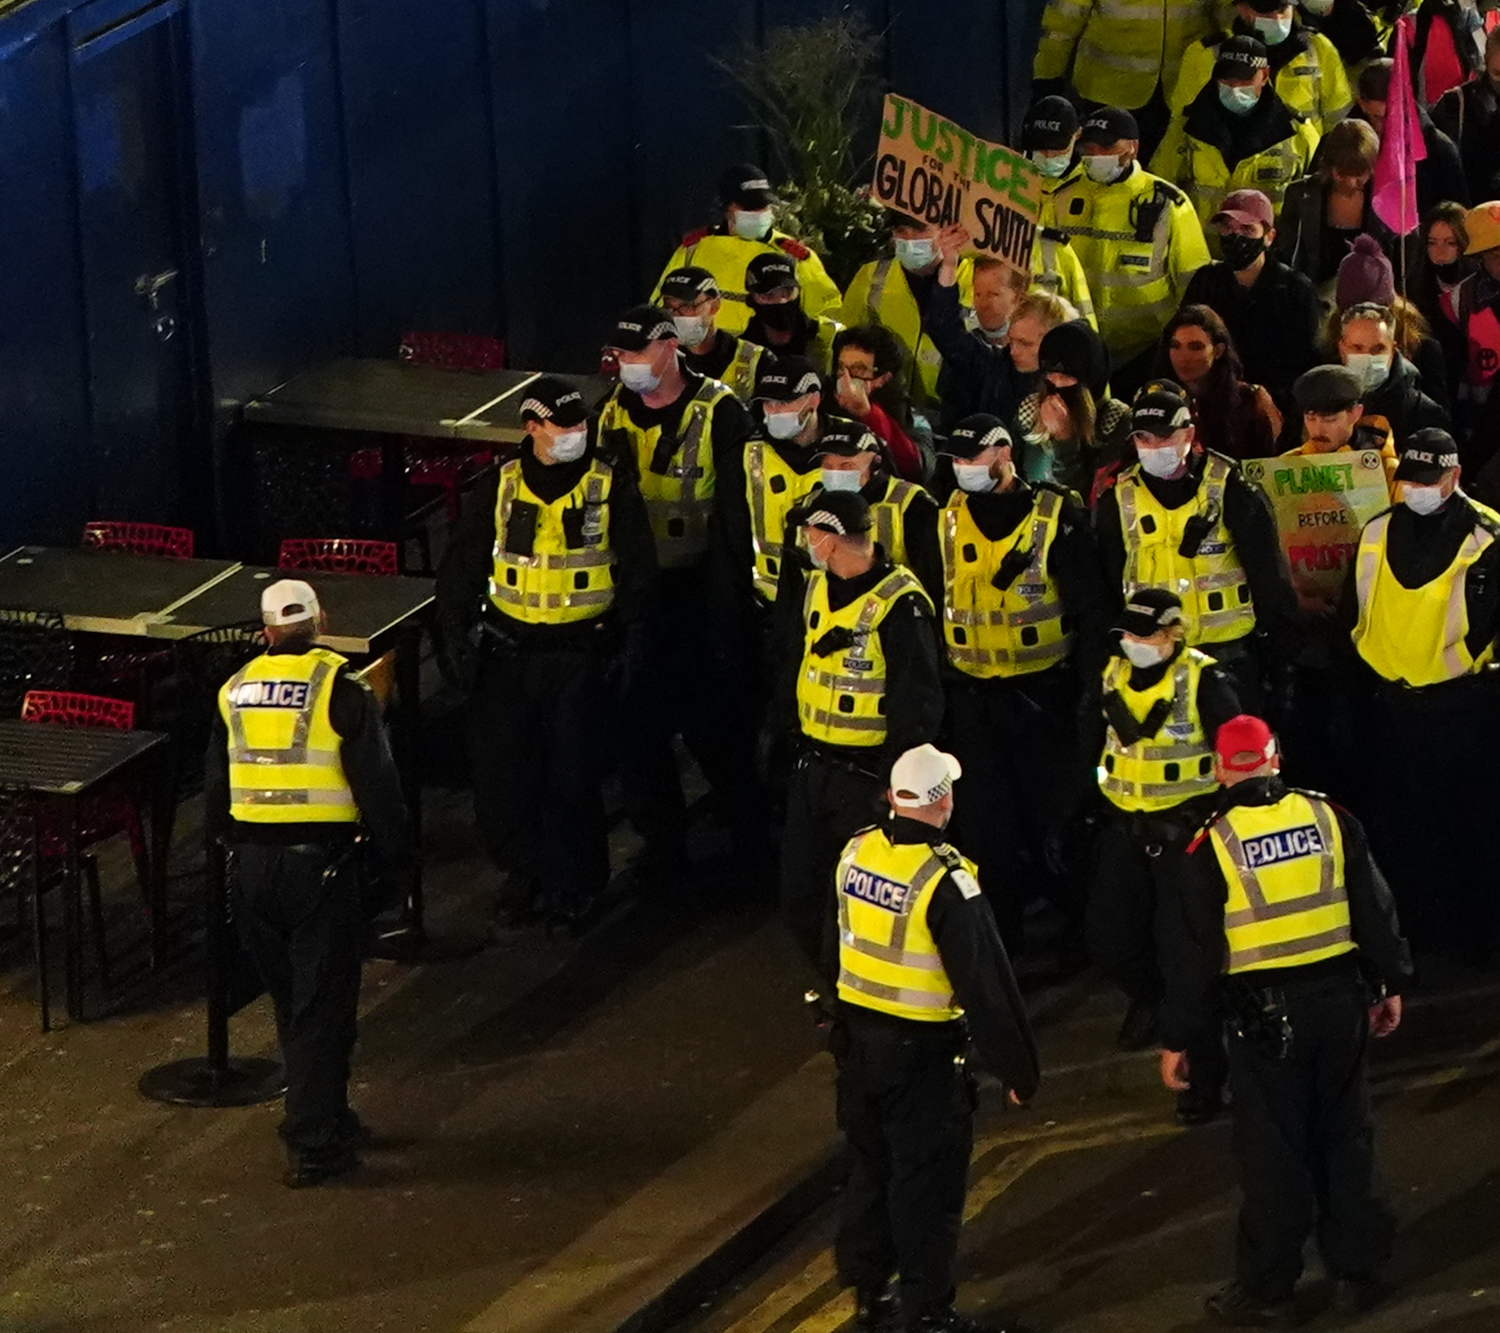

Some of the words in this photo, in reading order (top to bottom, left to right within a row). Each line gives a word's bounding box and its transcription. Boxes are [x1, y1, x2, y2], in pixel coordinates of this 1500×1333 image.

[1033, 120, 1061, 132] POLICE
[881, 96, 1041, 214] JUSTICE
[922, 154, 944, 173] FOR
[953, 172, 970, 192] THE
[877, 153, 962, 228] GLOBAL
[973, 197, 1036, 270] SOUTH
[762, 375, 789, 386] POLICE
[1135, 407, 1165, 419] POLICE
[1405, 450, 1433, 464] POLICE
[1274, 463, 1355, 496] PLANET
[1298, 509, 1348, 528] BEFORE
[237, 683, 309, 710] POLICE
[1244, 827, 1324, 867] POLICE
[843, 867, 908, 911] POLICE
